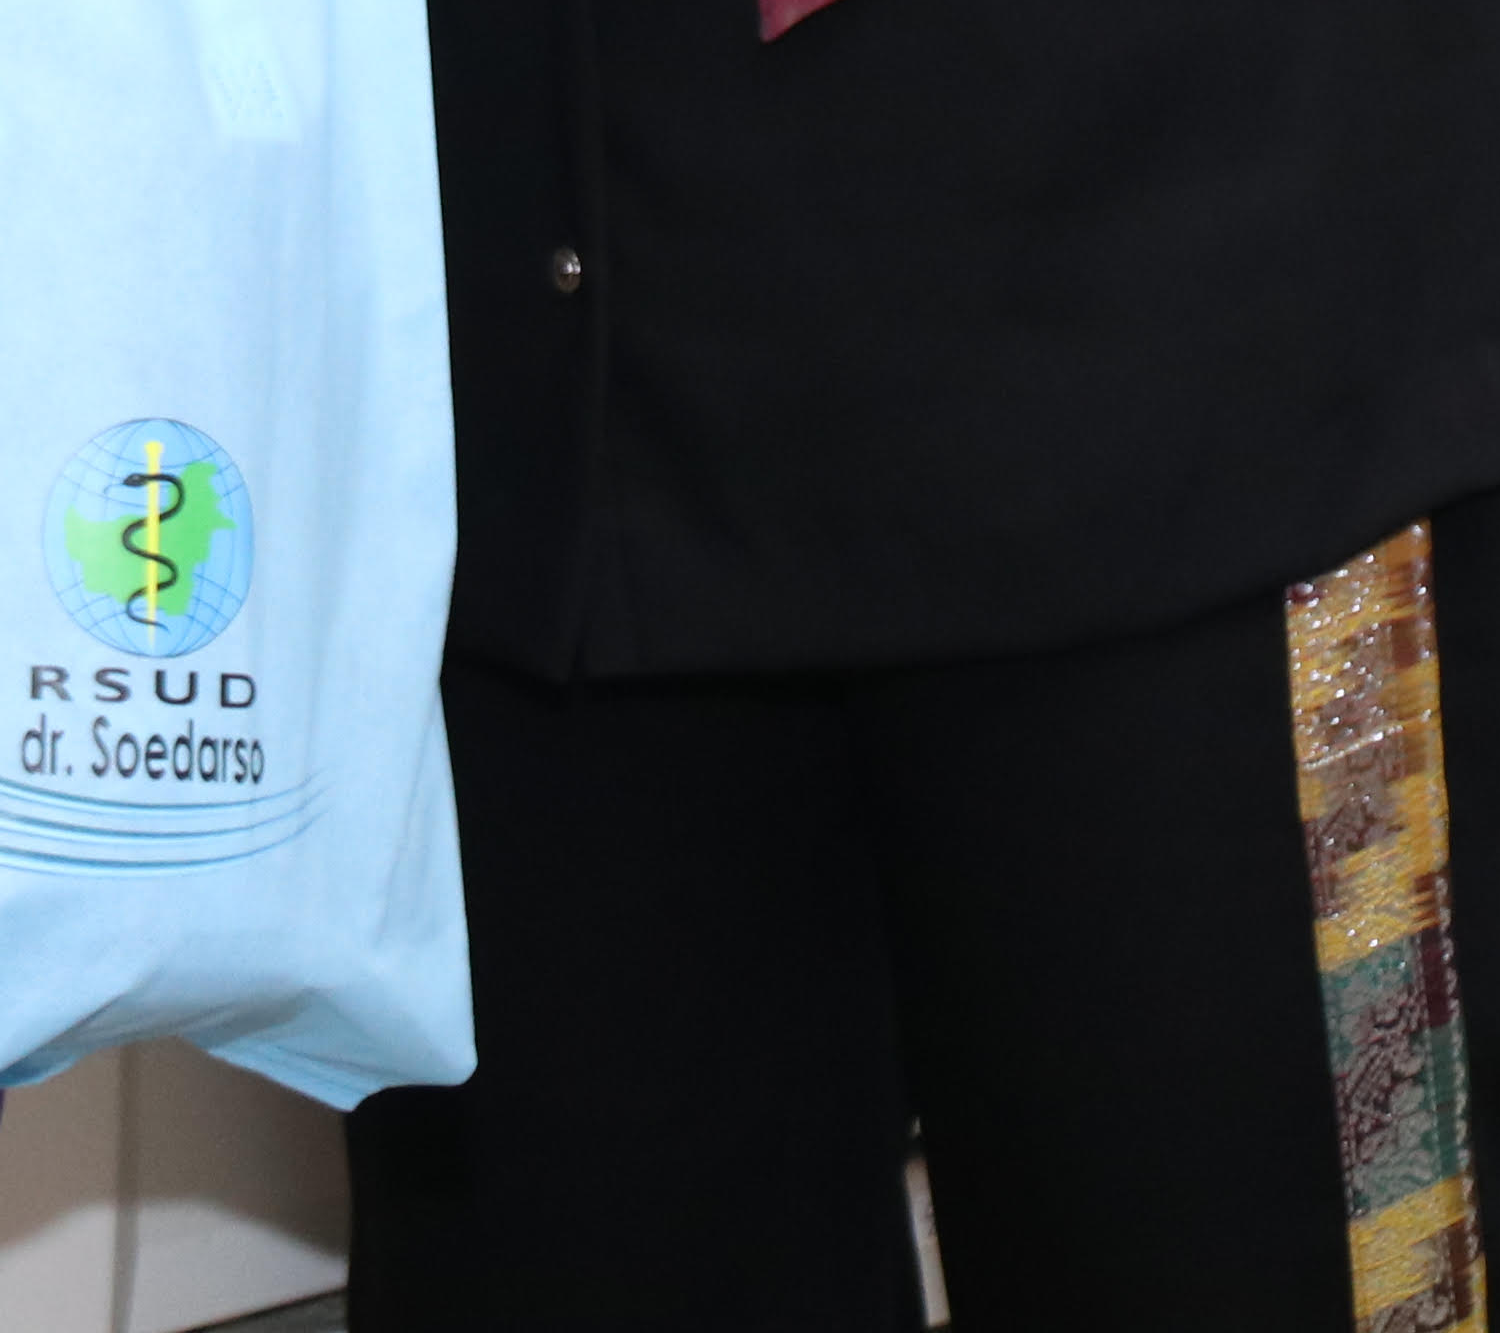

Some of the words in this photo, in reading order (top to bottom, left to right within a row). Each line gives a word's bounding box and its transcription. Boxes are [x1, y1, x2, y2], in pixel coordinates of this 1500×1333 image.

[29, 665, 257, 708] RSUD
[21, 713, 73, 776] dr.
[91, 715, 265, 785] Soedarso
